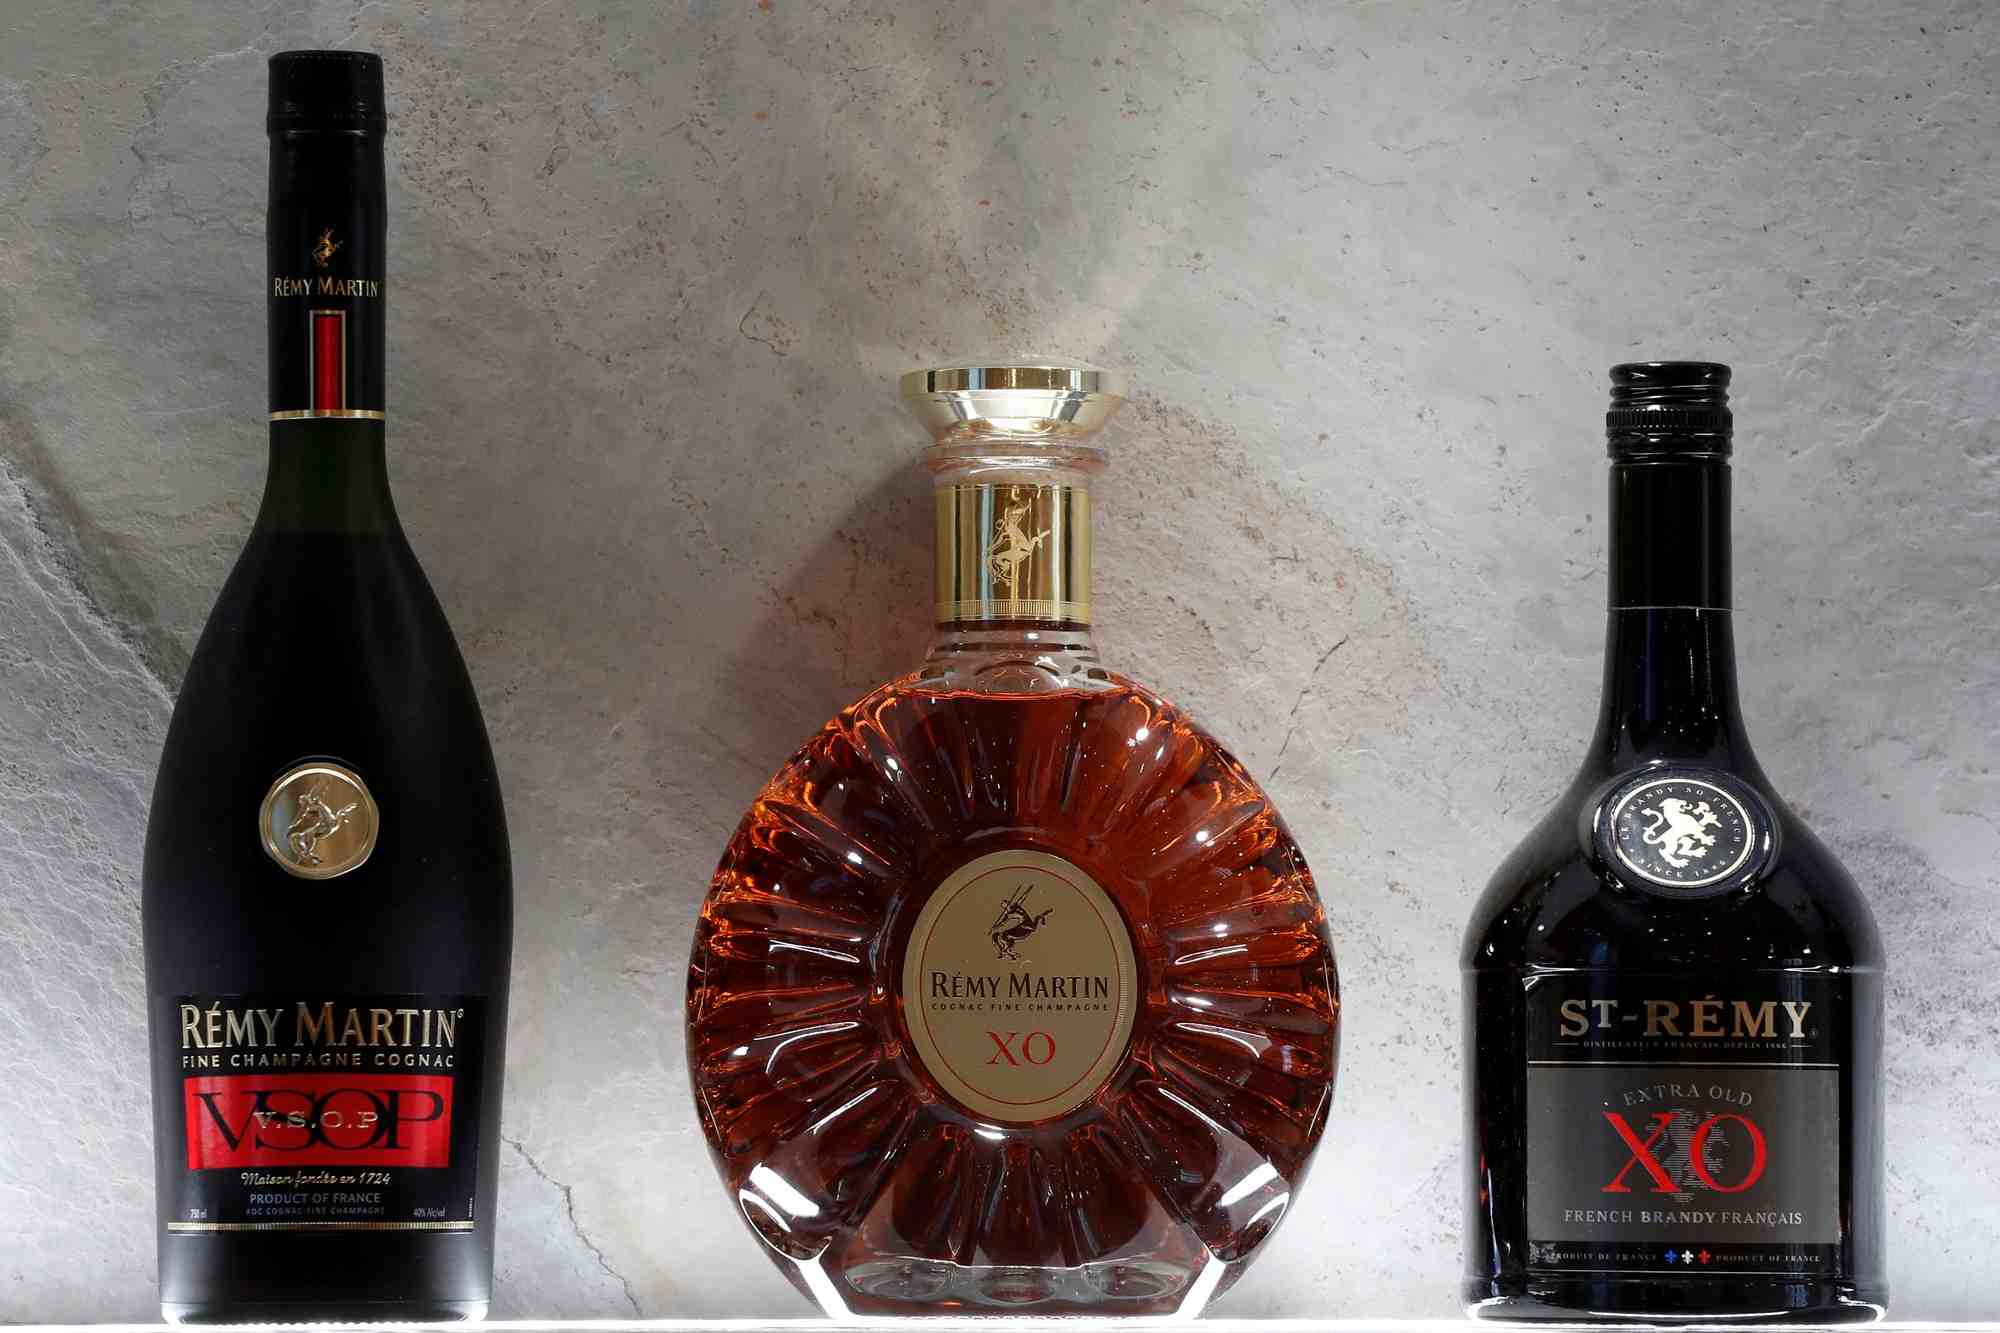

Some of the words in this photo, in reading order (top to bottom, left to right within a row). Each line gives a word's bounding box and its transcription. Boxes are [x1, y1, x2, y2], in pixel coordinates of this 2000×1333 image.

[274, 276, 313, 297] RÉMY
[319, 275, 378, 297] MARTIN
[931, 971, 1001, 998] RÉMY
[1008, 973, 1109, 999] MARTIN
[931, 1003, 984, 1012] COGNAC
[991, 1003, 1020, 1012] FINE
[1028, 1003, 1109, 1012] CHAMPAGNE
[1560, 995, 1811, 1038] ST-RÉMY
[180, 1001, 284, 1049] RÉMY
[985, 1030, 1057, 1066] XO
[182, 1055, 221, 1069] FINE
[230, 1053, 362, 1068] CHAMPAGNE
[374, 1053, 455, 1068] COGNAC
[1622, 1083, 1700, 1107] EXTRA
[1708, 1086, 1754, 1108] OLD
[192, 1088, 445, 1153] VSOP
[1600, 1111, 1768, 1193] XO
[358, 1172, 393, 1185] 1724
[250, 1193, 308, 1205] PRODUCT
[311, 1193, 330, 1204] OF
[333, 1192, 383, 1204] FRANCE
[1563, 1210, 1633, 1224] FRENCH
[1640, 1211, 1718, 1225] BRANDY
[1721, 1211, 1803, 1228] FRANÇAIS
